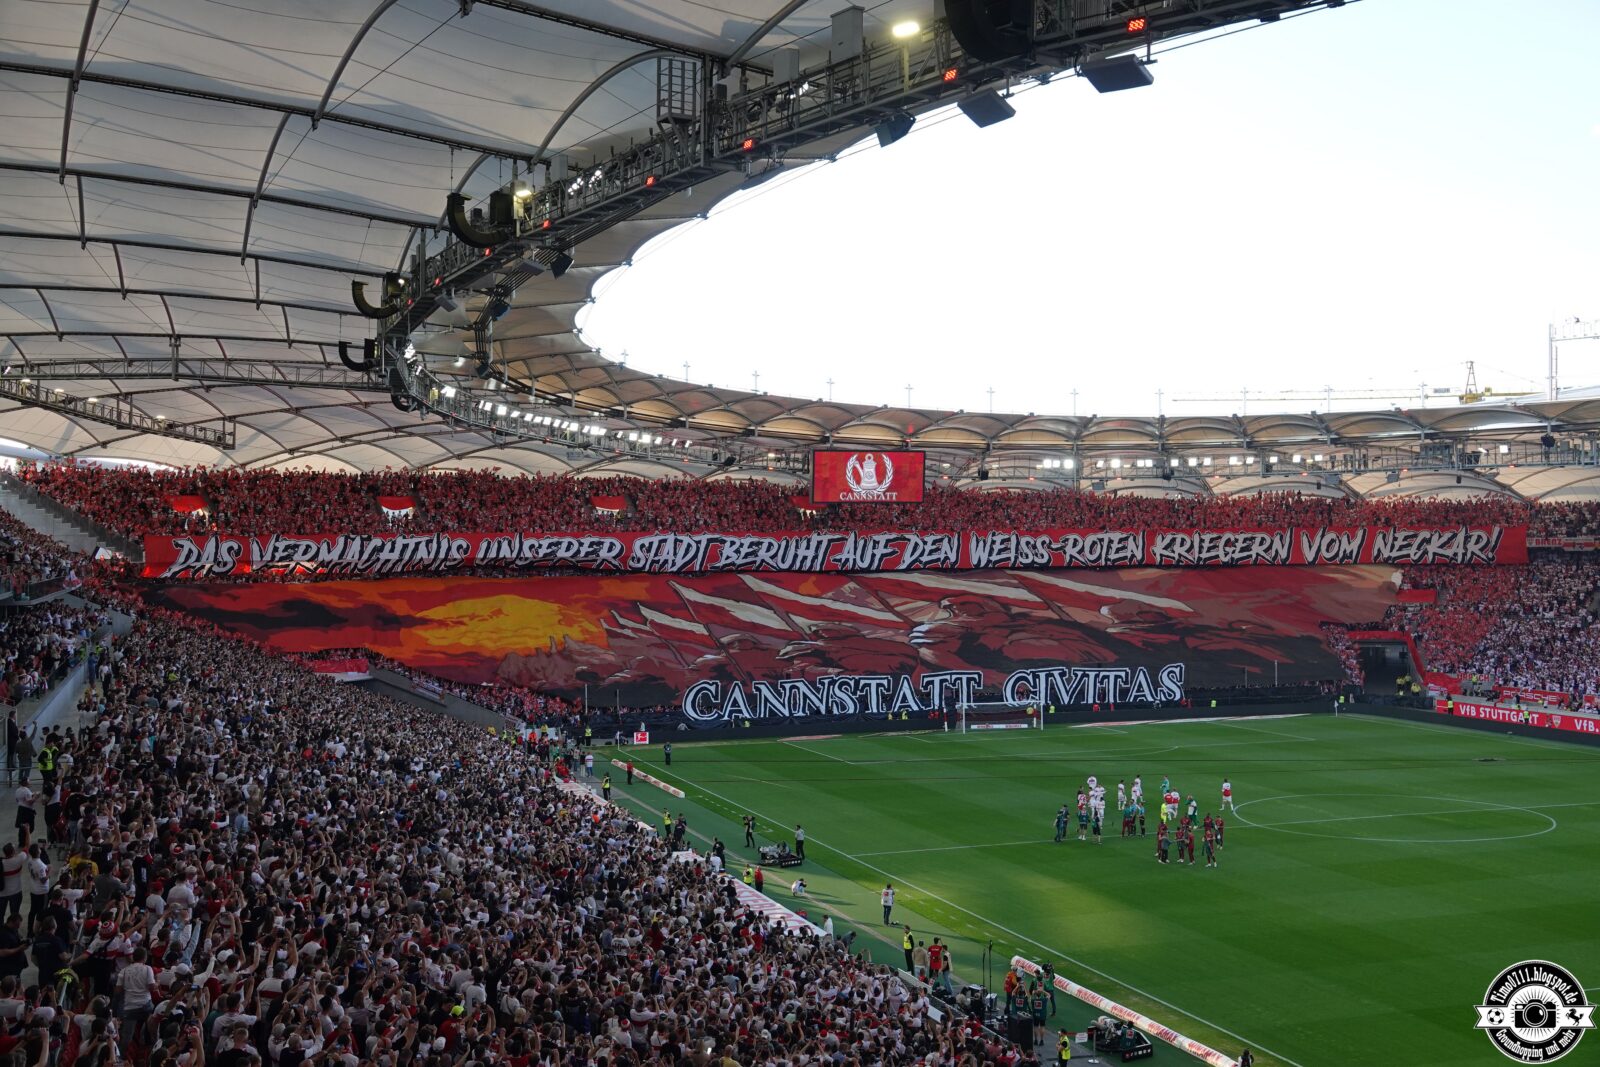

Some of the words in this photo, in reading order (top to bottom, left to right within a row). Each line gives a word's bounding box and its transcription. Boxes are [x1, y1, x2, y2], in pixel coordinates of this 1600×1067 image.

[840, 491, 898, 501] CANNSTATT
[160, 533, 244, 578] DAS
[629, 531, 722, 572] STADT
[711, 531, 847, 572] BERUHT
[833, 531, 901, 571] AUF
[897, 531, 960, 570] DEN
[969, 529, 1147, 569] WEISS-ROTEN
[1151, 528, 1295, 567] KRIEGERN
[1301, 526, 1368, 566] VOM
[1373, 525, 1504, 566] NECKAR!
[683, 669, 985, 721] CANNSTATT
[1002, 662, 1186, 708] CIVITAS
[1459, 704, 1477, 717] VfB
